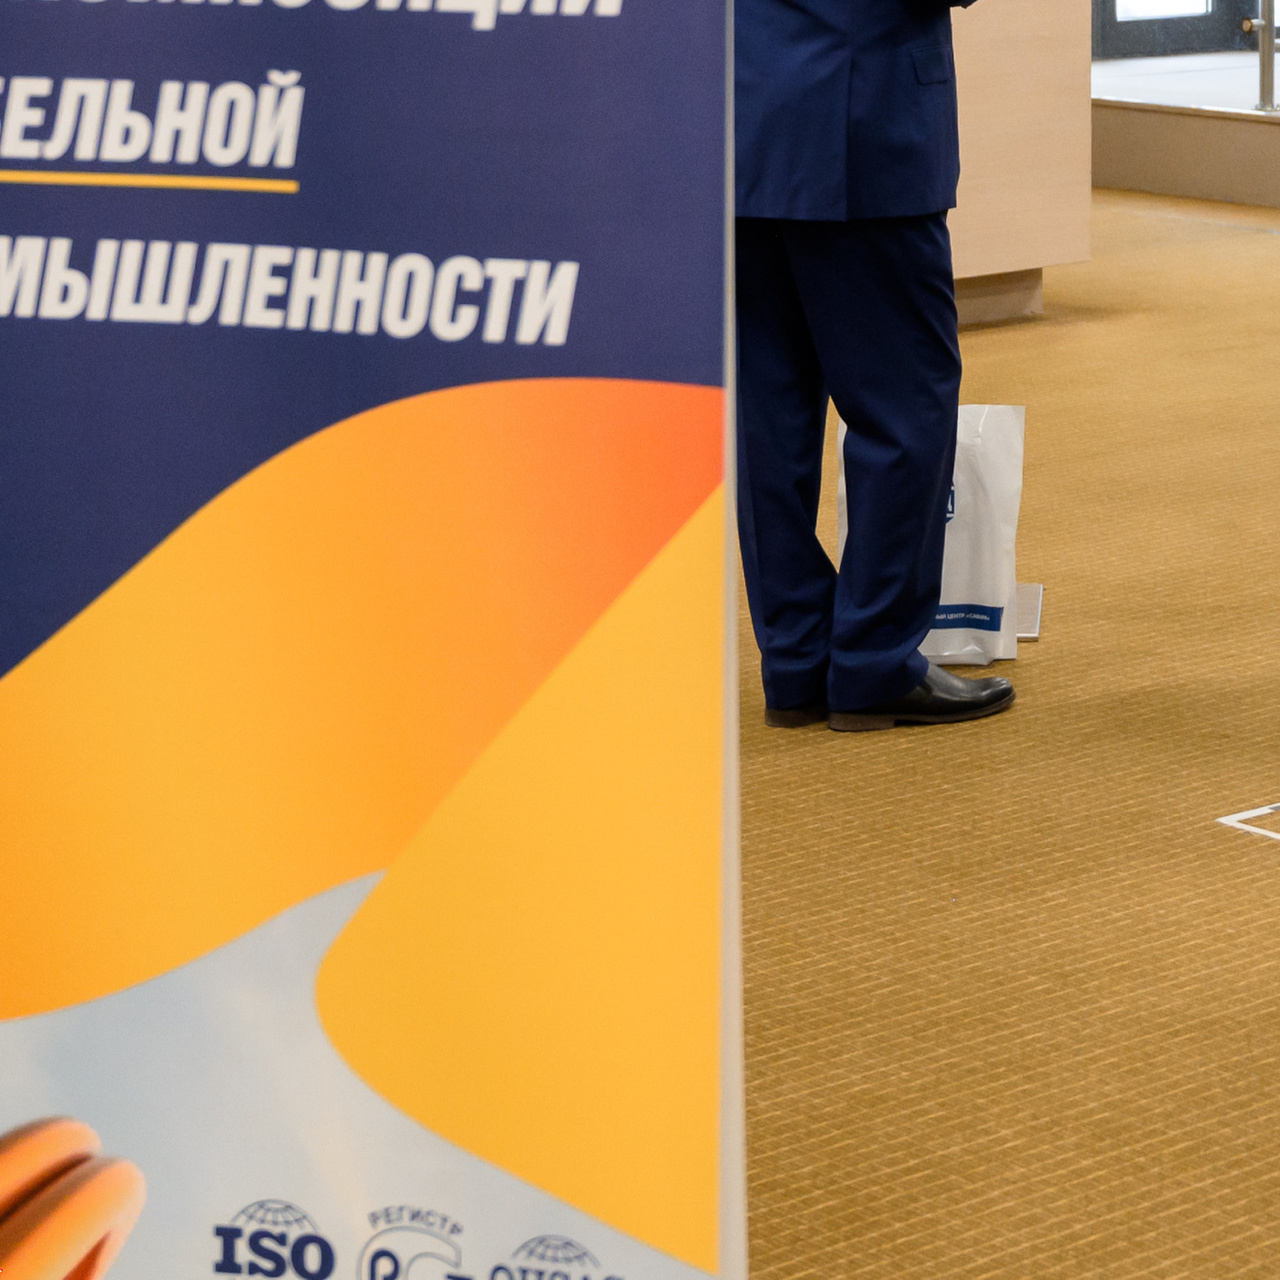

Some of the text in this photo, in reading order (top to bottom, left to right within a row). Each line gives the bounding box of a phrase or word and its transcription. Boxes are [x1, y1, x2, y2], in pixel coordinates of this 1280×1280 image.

[0, 70, 306, 169] ЕЛЬНОЙ
[368, 1205, 463, 1236] РЕГИСТР
[213, 1226, 336, 1280] ISO
